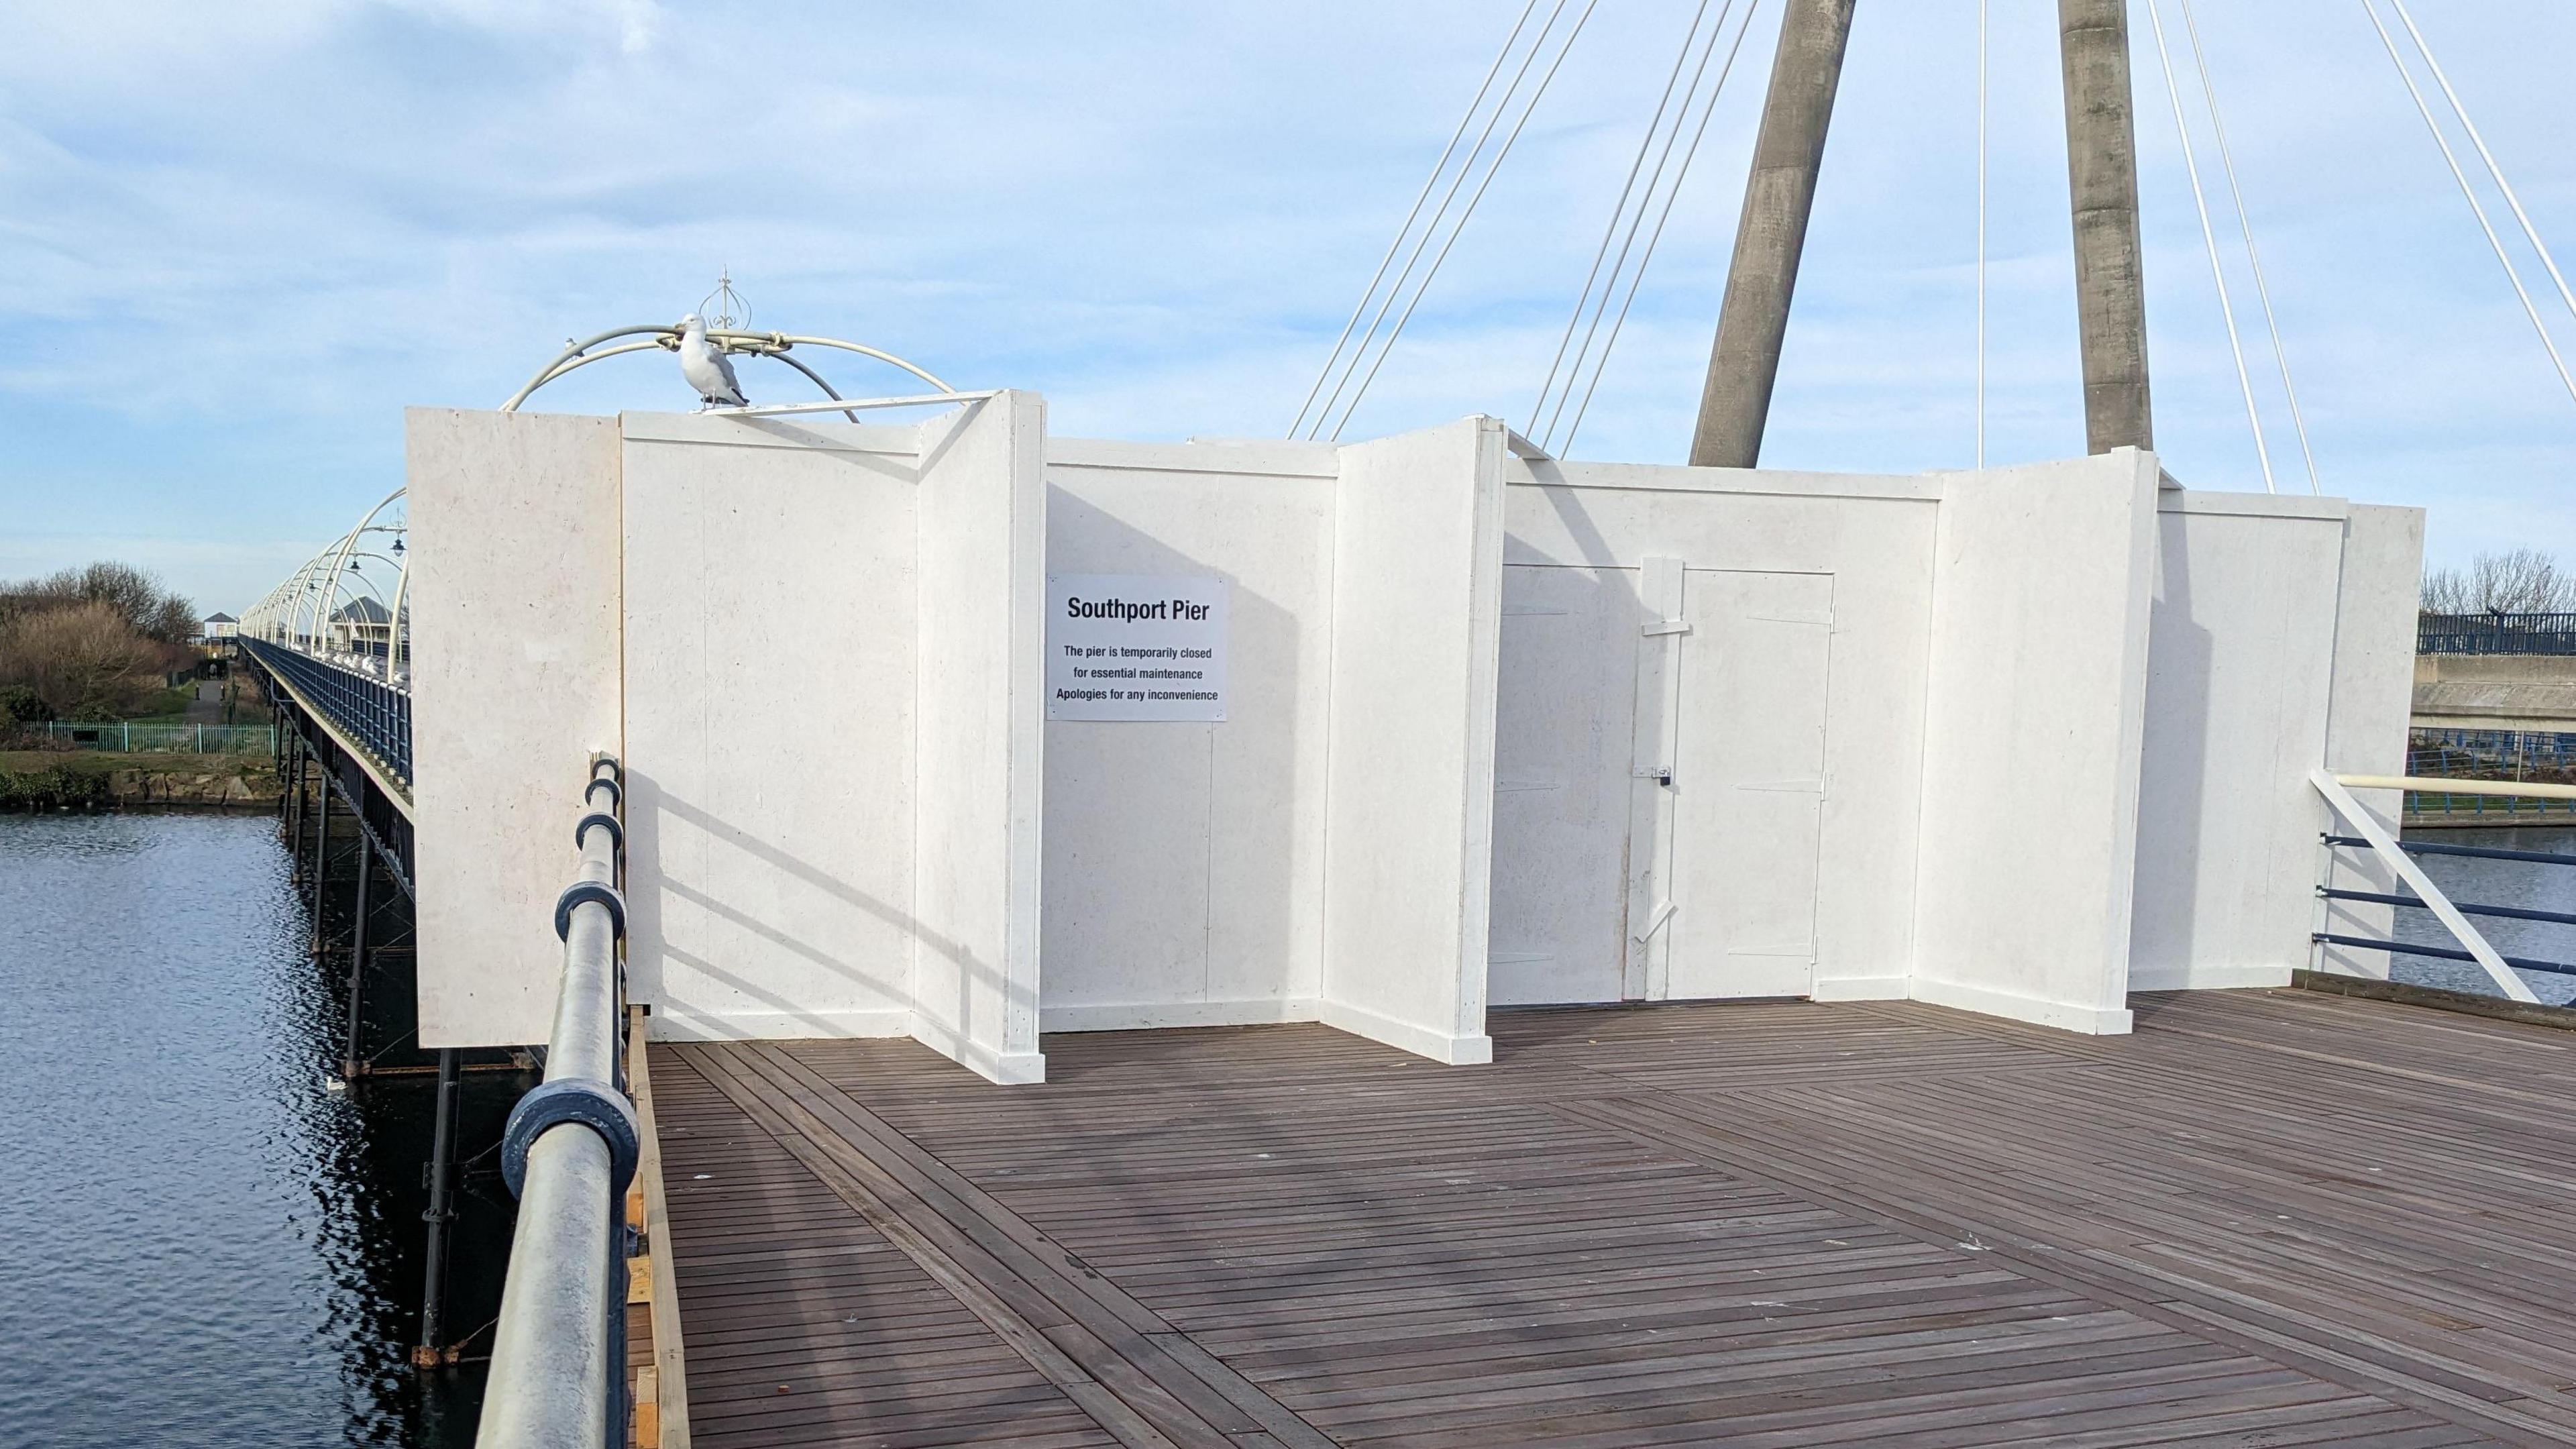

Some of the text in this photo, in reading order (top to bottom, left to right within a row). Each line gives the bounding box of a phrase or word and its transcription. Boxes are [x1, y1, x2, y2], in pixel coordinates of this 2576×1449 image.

[1068, 597, 1209, 623] Southport Pier
[1064, 645, 1212, 659] The pier is temporarily closed
[1073, 667, 1202, 679] for essential maintenance
[1057, 688, 1218, 702] Apologies for any inconvenience
